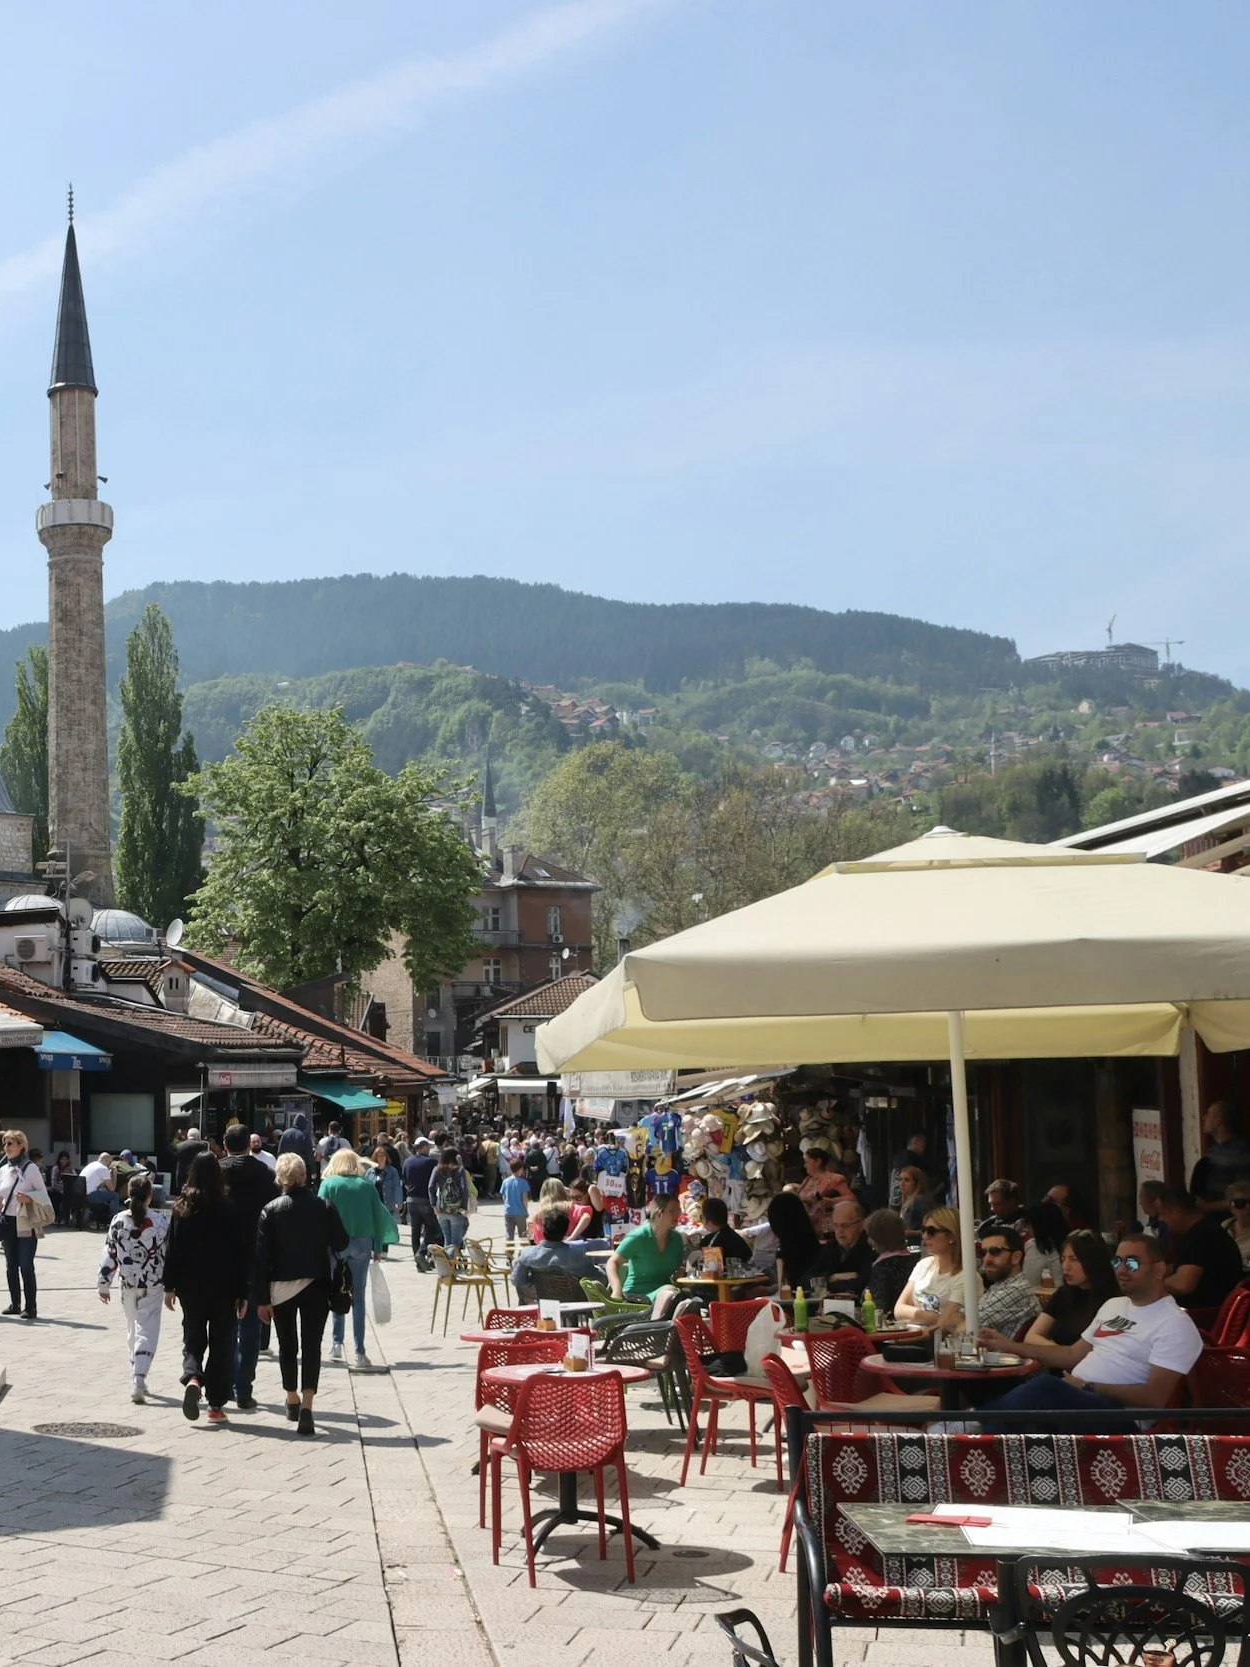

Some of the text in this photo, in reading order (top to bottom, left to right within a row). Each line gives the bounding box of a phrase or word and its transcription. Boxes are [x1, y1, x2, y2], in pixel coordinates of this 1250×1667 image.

[605, 1178, 614, 1187] 30
[655, 1181, 668, 1194] 11
[630, 1210, 641, 1226] 23
[1102, 1315, 1137, 1330] NIKE
